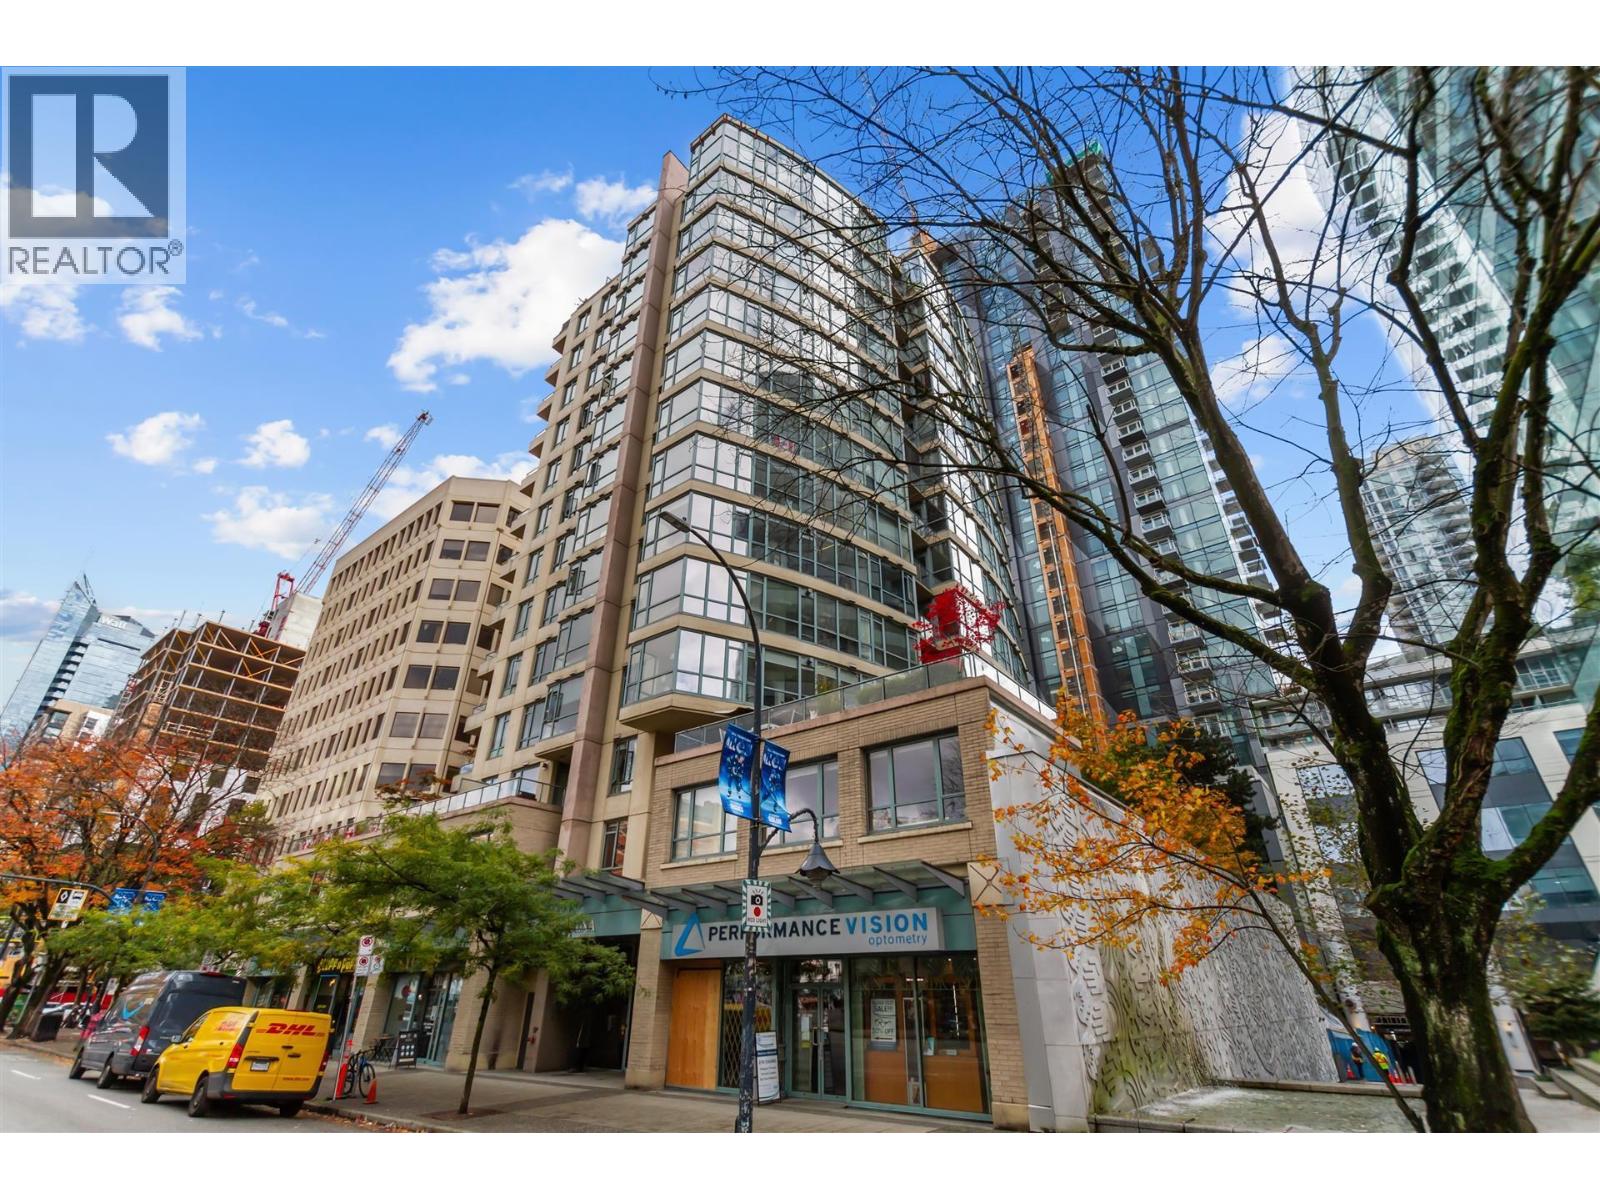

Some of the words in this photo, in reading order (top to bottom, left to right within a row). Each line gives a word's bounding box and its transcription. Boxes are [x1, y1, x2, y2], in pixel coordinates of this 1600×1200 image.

[708, 918, 841, 941] PERMANCE
[845, 912, 928, 935] VISION
[868, 934, 928, 947] optometry
[266, 1023, 316, 1036] DHL
